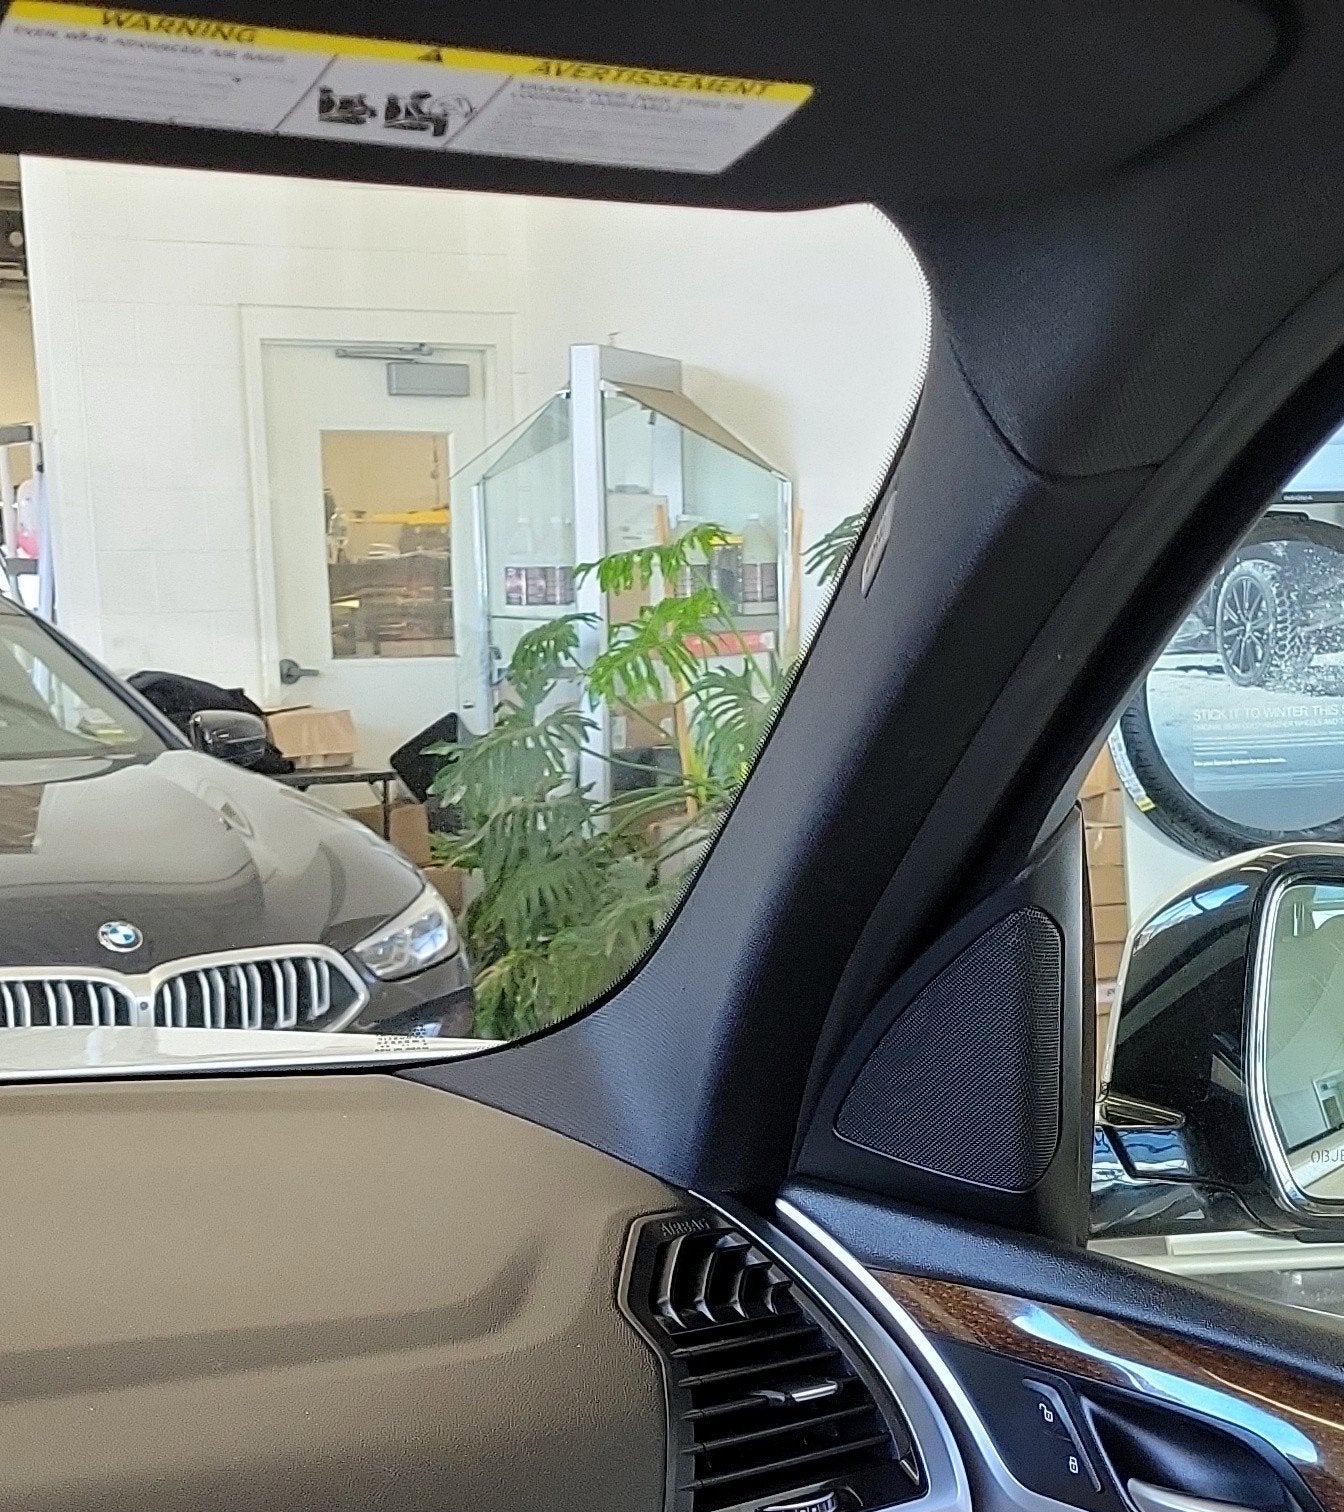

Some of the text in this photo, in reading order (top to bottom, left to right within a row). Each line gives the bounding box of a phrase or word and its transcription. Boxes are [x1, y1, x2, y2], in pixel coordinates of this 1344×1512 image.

[102, 9, 256, 45] WARNING
[533, 59, 768, 96] AVERTISSEMENT
[1262, 705, 1309, 719] WINTER
[1312, 703, 1339, 716] THIS
